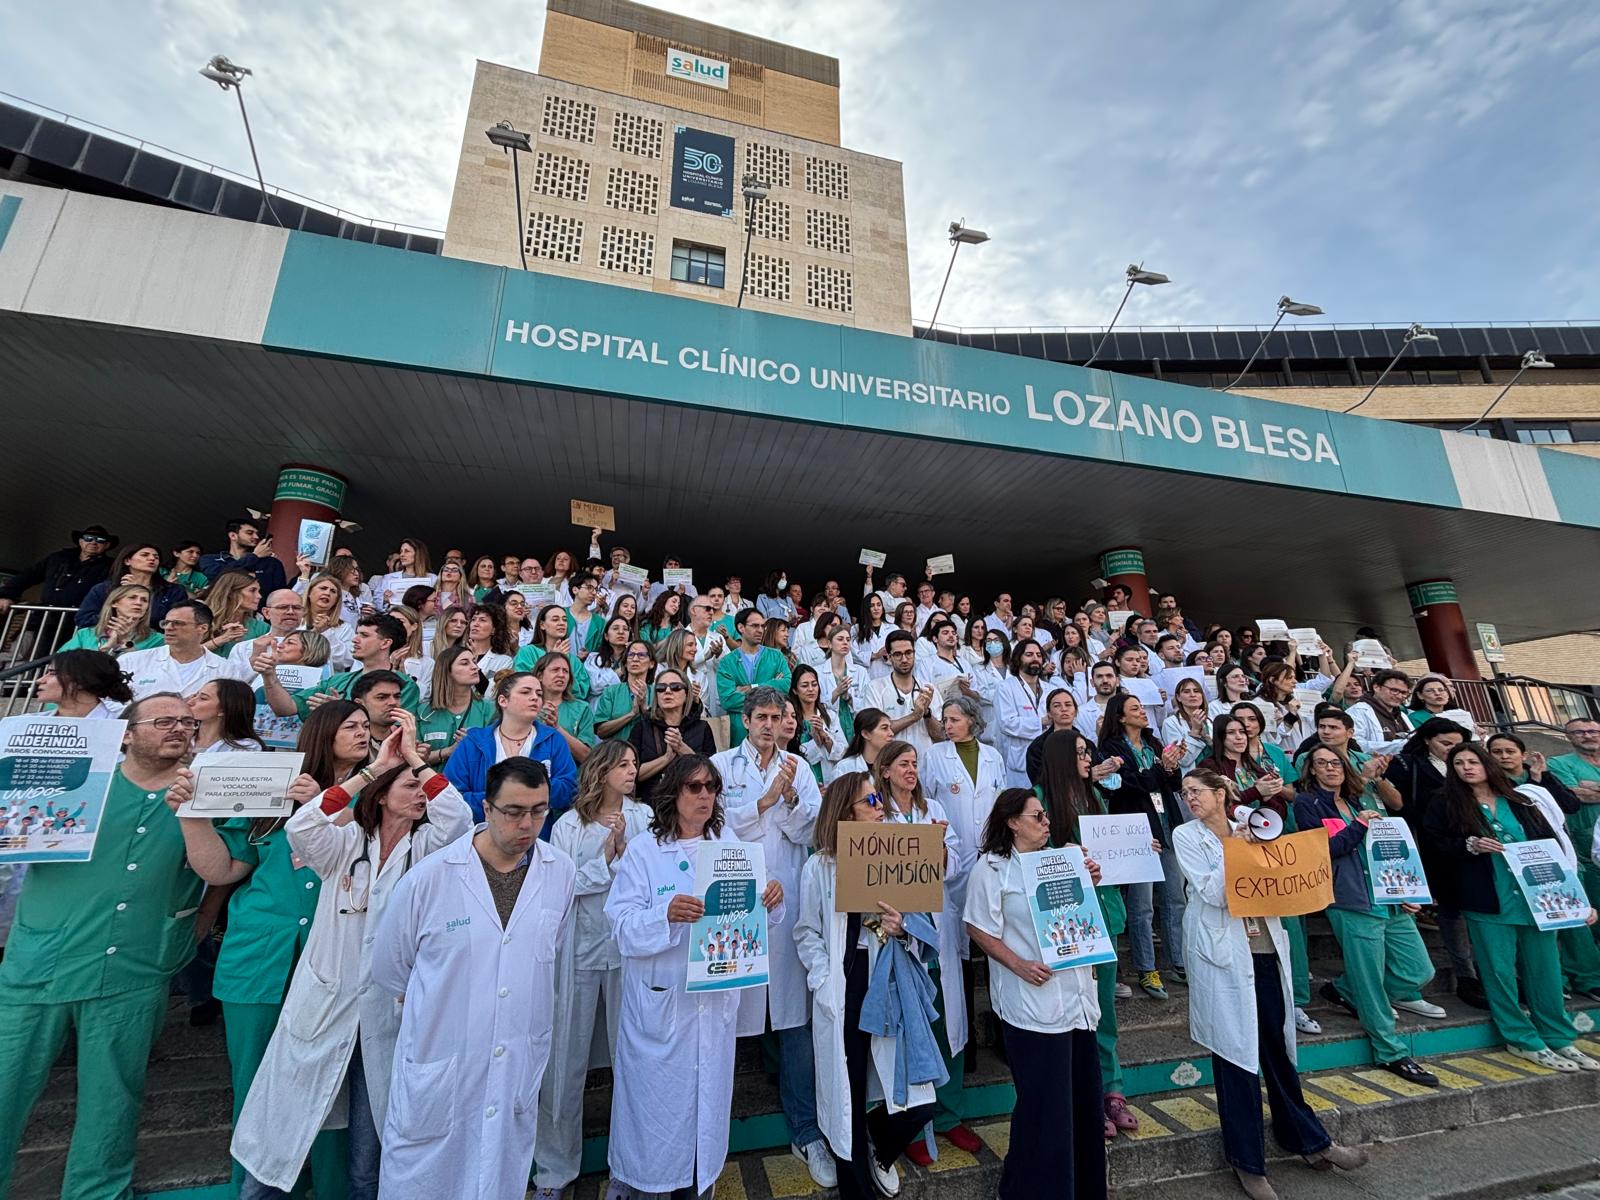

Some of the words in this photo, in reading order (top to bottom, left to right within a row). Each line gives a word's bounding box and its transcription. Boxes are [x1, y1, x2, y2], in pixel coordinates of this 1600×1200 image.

[672, 57, 724, 79] salud
[505, 319, 669, 366] HOSPITAL
[678, 347, 800, 384] CLÍNICO
[810, 367, 1010, 416] UNIVERSITARIO
[1025, 384, 1203, 444] LOZANO
[1211, 414, 1340, 466] BLESA
[26, 724, 78, 736] HUELGA
[8, 735, 87, 748] INDEFINIDA
[2, 786, 66, 800] UNIDOS
[1092, 826, 1106, 838] NO
[1110, 824, 1120, 834] ES
[722, 849, 746, 860] HUELGA
[1041, 854, 1067, 867] HUELGA
[1092, 851, 1102, 860] ES
[1261, 842, 1296, 868] NO
[714, 860, 752, 872] INDEFINIDA
[1036, 862, 1074, 876] INDEFINIDA
[1235, 862, 1330, 898] EXPLOTACIÓN
[657, 883, 675, 893] salud
[446, 916, 470, 928] salud
[717, 909, 748, 925] UNIDOS
